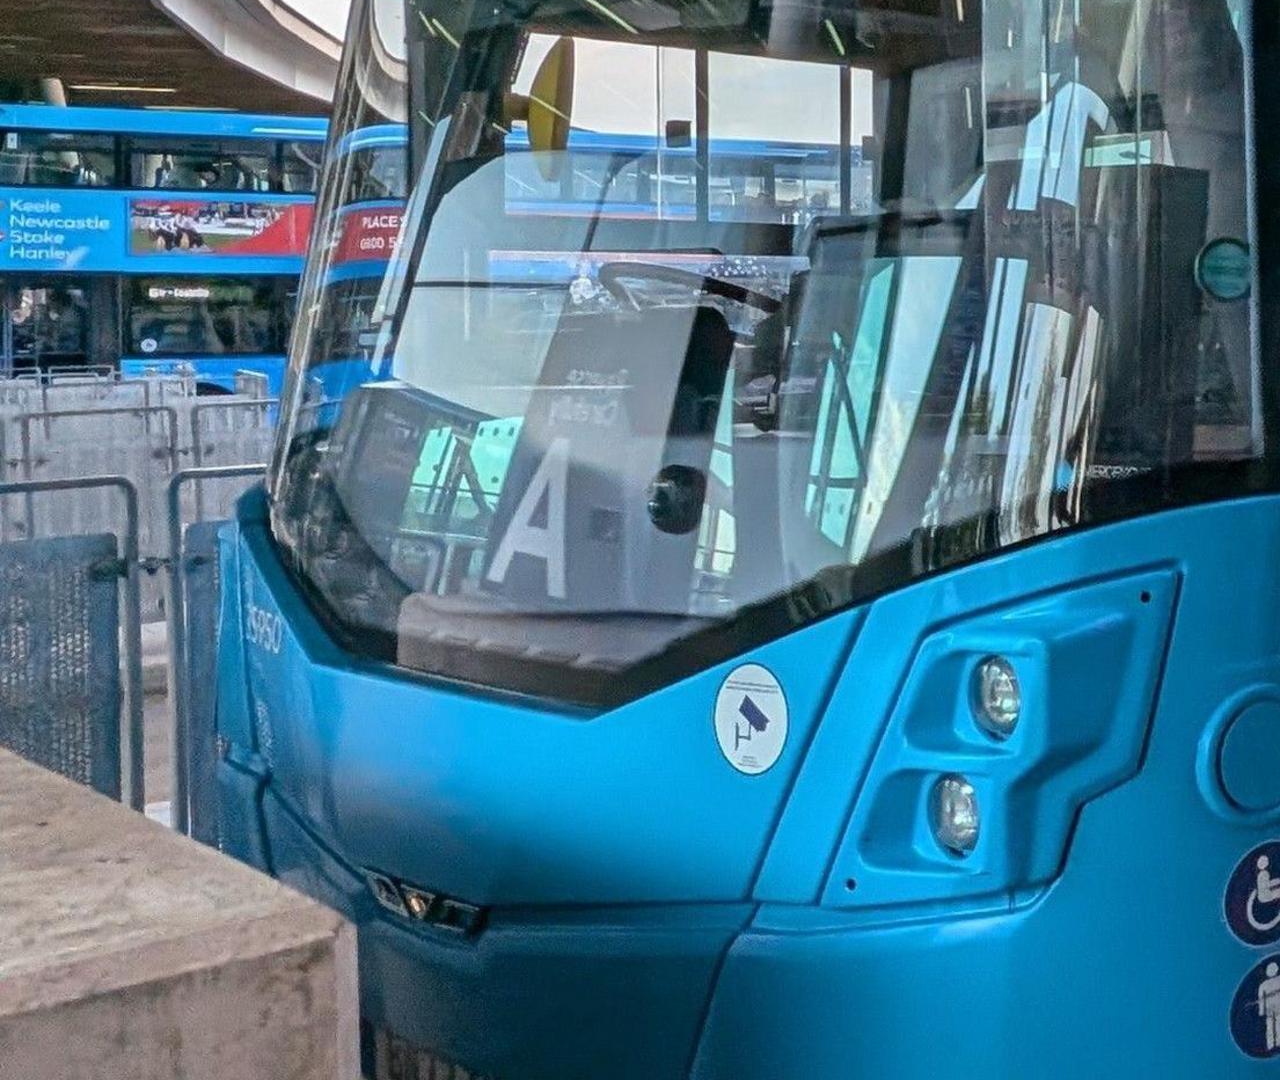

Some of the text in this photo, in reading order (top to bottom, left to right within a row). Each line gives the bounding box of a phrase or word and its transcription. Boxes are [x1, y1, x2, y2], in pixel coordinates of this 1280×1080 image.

[9, 198, 62, 213] Keele
[9, 214, 111, 230] Newcastle
[9, 230, 65, 245] Stoke
